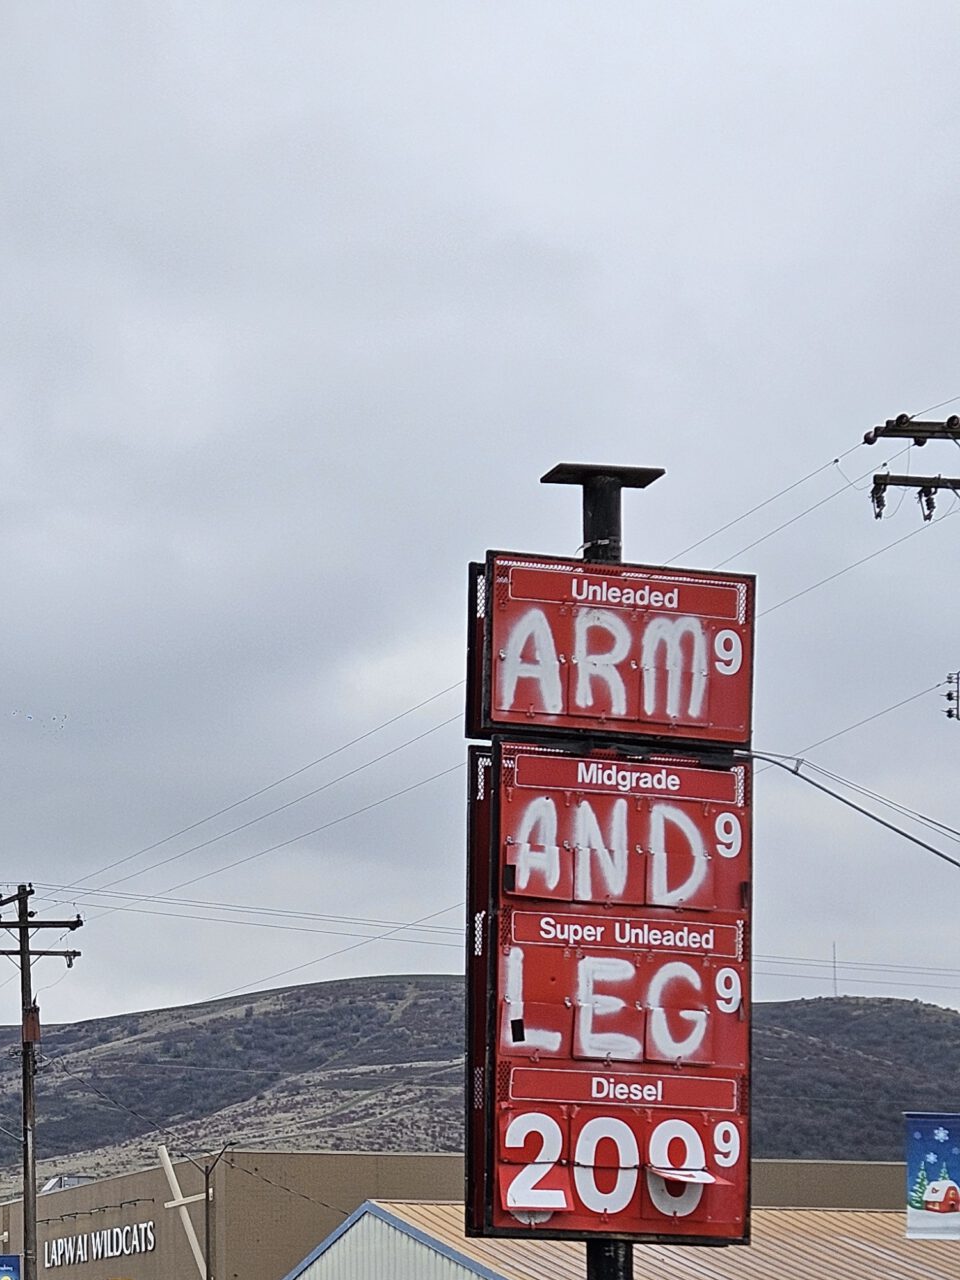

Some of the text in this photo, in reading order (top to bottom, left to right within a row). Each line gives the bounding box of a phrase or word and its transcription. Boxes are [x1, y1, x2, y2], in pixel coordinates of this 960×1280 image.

[571, 578, 679, 608] Unleaded
[501, 607, 708, 717] ARM
[714, 629, 743, 676] 9
[577, 762, 681, 791] Midgrade
[514, 796, 707, 903] AND
[714, 812, 743, 858] 9
[539, 917, 714, 950] Super Unleaded
[505, 946, 708, 1060] LEG
[714, 967, 742, 1013] 9
[591, 1076, 663, 1102] Diesel
[44, 1220, 155, 1269] LAPWAI WILDCATS
